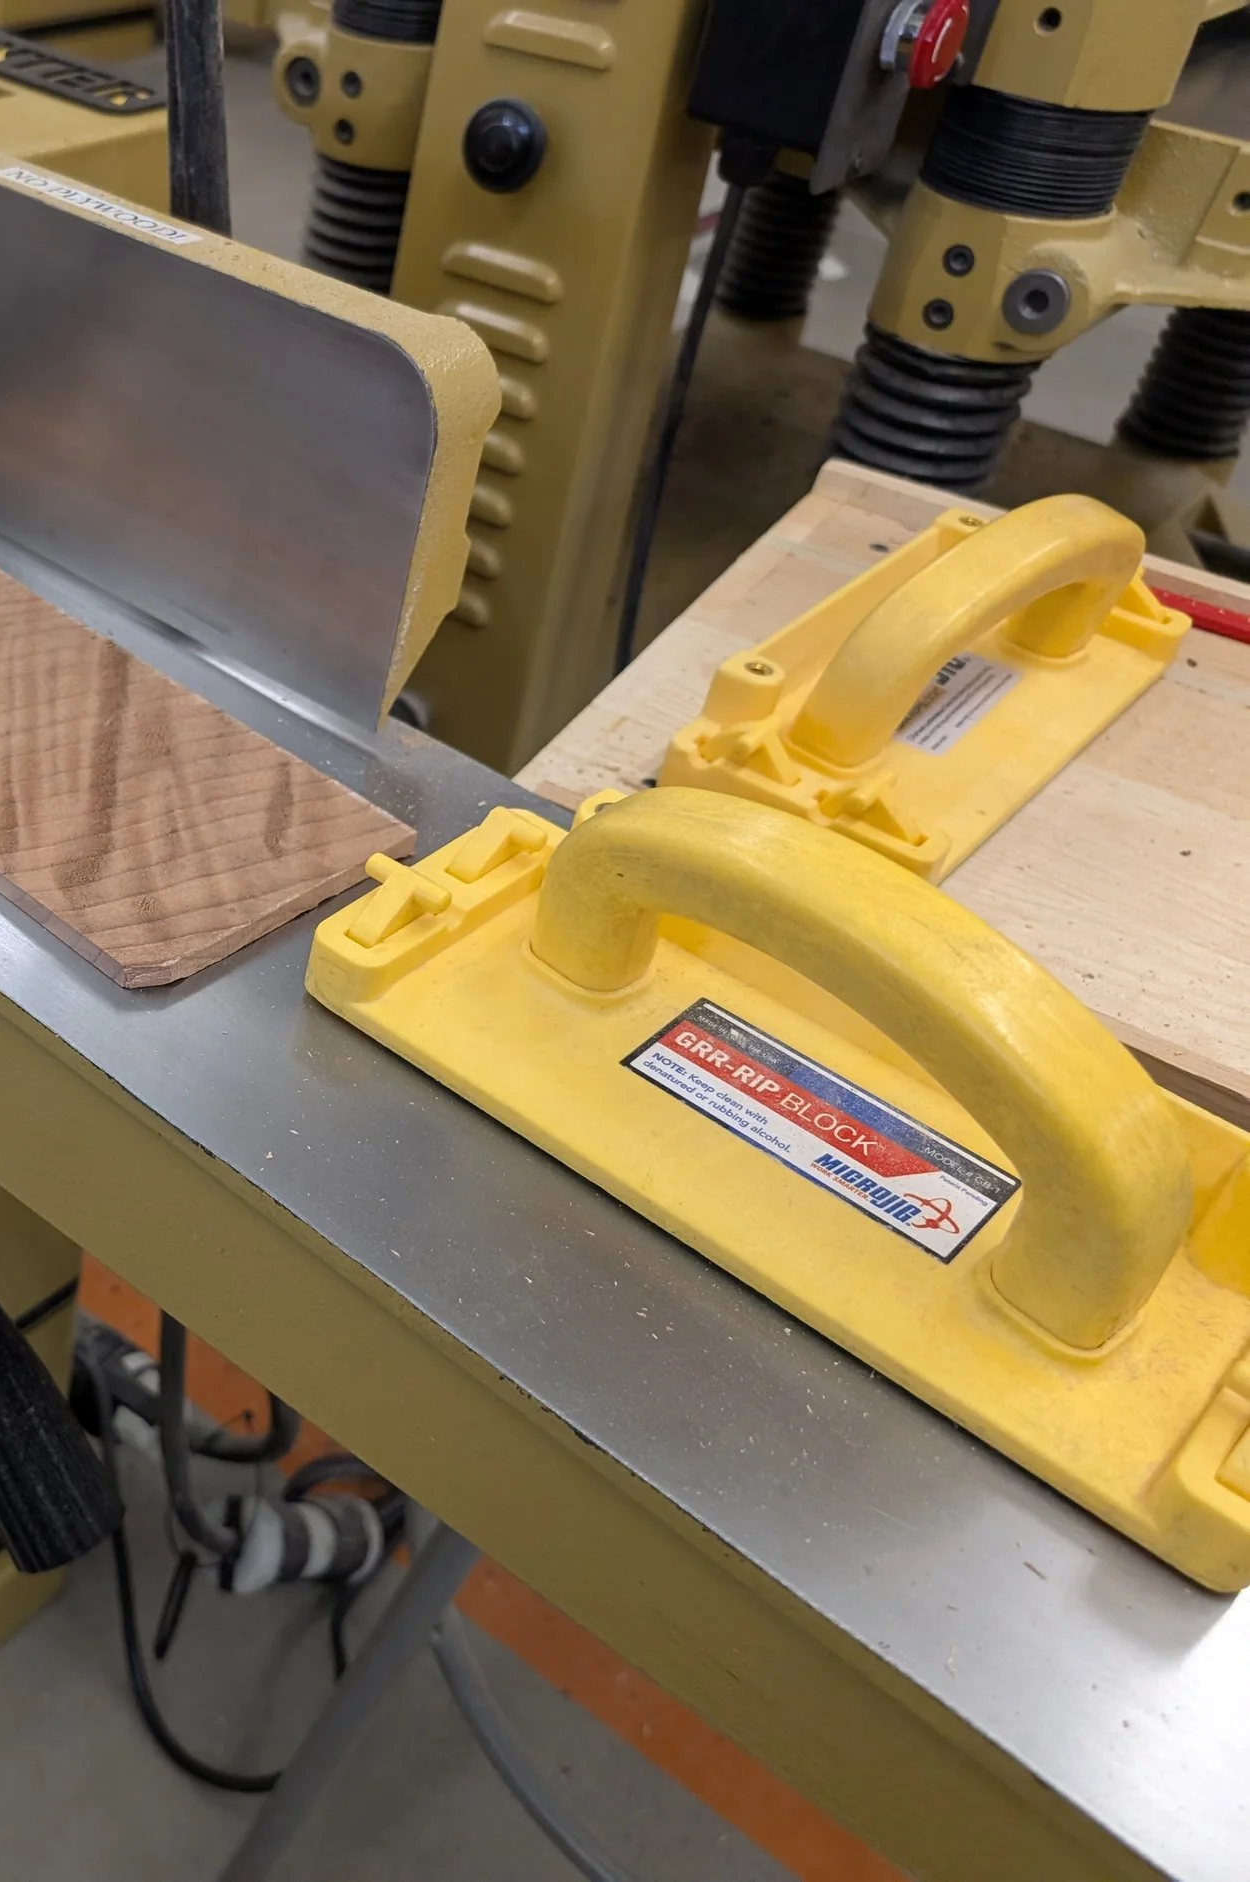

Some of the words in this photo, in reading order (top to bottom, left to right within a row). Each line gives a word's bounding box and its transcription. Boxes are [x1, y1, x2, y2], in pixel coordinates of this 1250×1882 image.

[7, 170, 48, 188] NO
[50, 186, 187, 240] PLYWOOD!
[699, 1015, 717, 1030] MADE
[643, 1060, 695, 1094] denatured
[695, 1091, 709, 1102] or
[708, 1099, 750, 1128] rubbing
[750, 1122, 791, 1153] alcohol.
[652, 1052, 687, 1076] NOTE:
[688, 1073, 715, 1094] Keep
[716, 1089, 744, 1111] clean
[745, 1107, 768, 1126] with
[674, 1031, 780, 1093] GRR-RIP
[779, 1092, 878, 1157] BLOCK
[809, 1161, 832, 1179] WORK
[832, 1175, 869, 1202] SMARTER.
[814, 1152, 922, 1223] MICROJIG
[924, 1146, 966, 1175] MODEL
[939, 1174, 960, 1191] Patent
[961, 1186, 989, 1207] Pending
